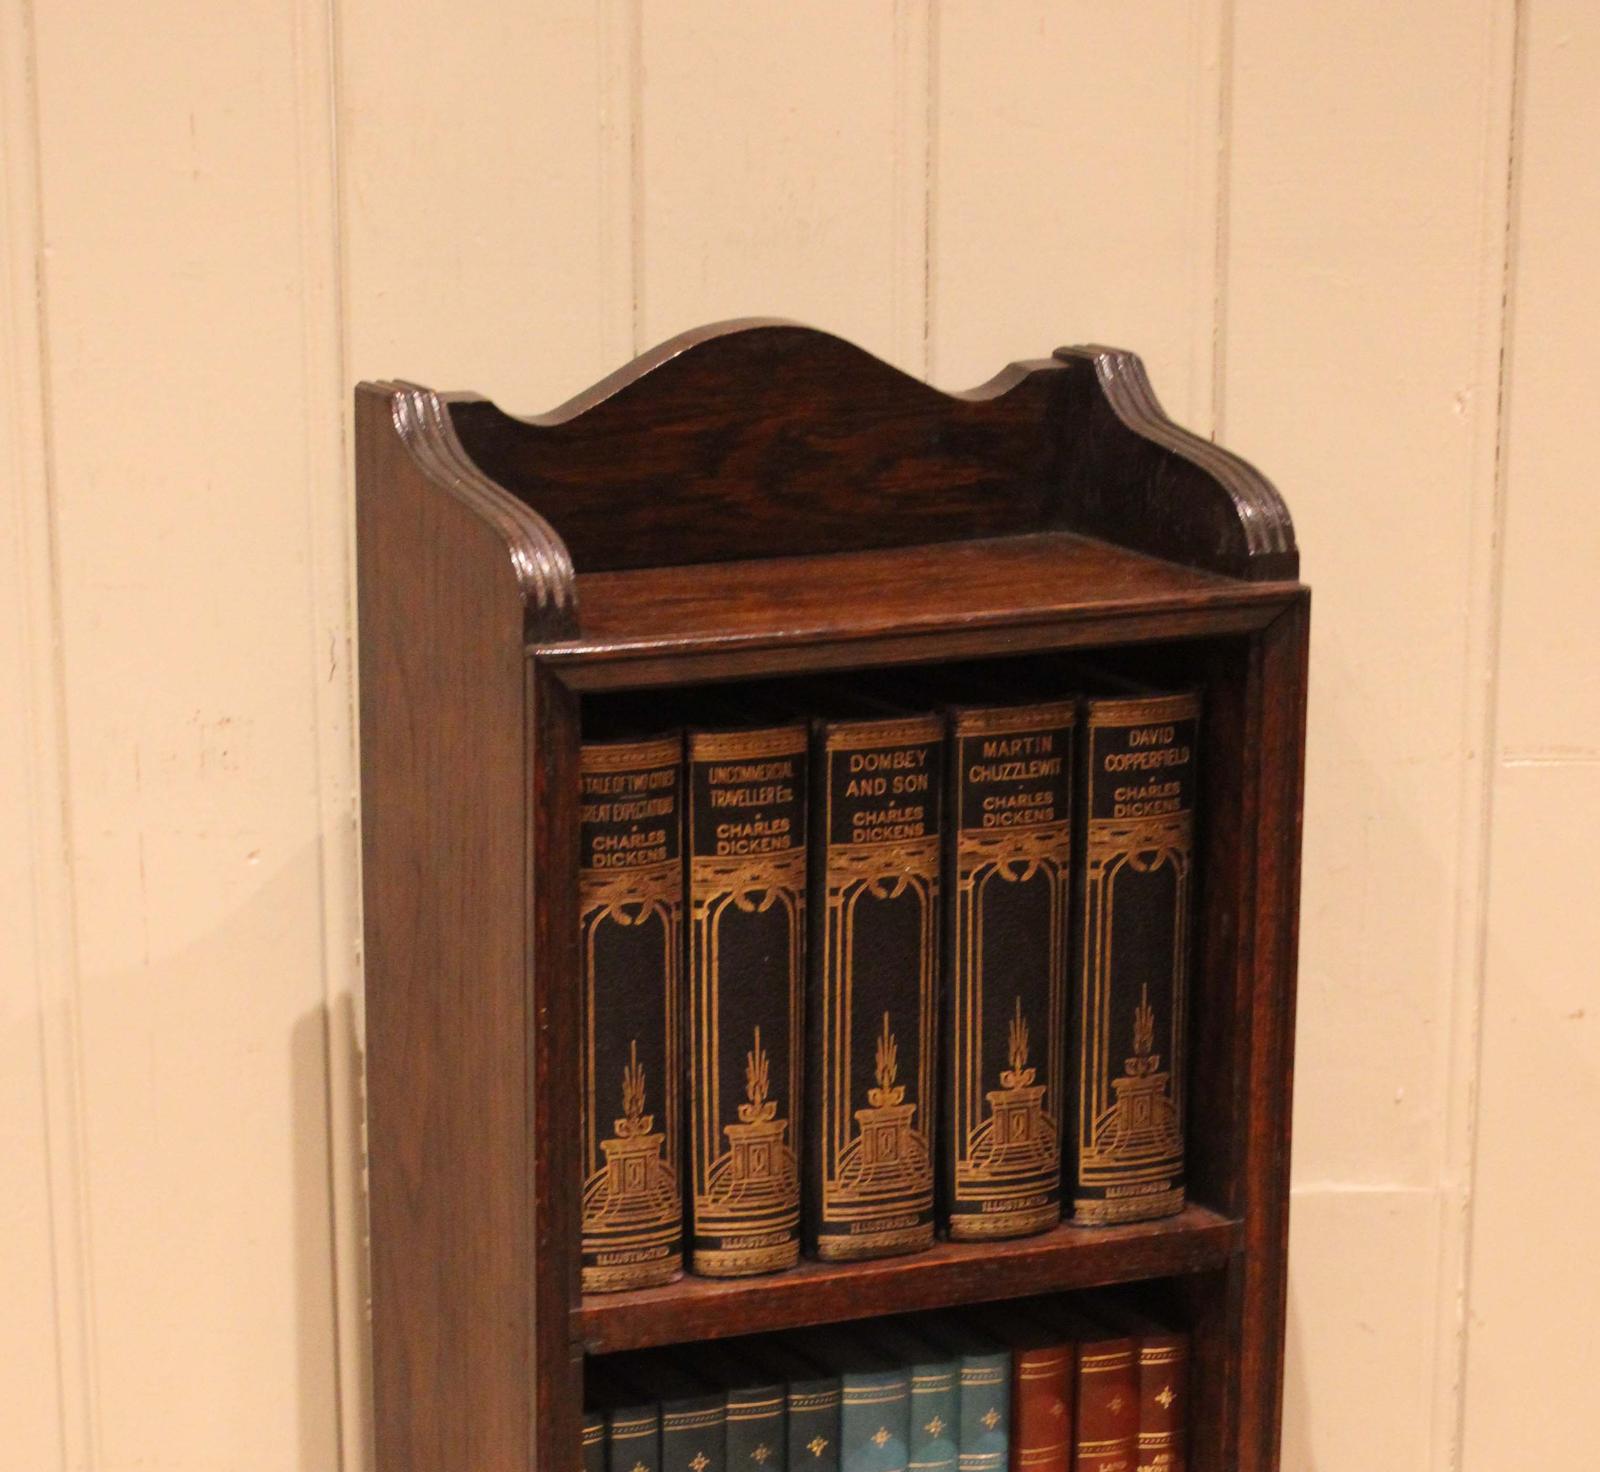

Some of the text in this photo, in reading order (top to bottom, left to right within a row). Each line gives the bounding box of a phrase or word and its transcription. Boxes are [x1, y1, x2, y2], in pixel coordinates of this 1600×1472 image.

[983, 735, 1053, 758] MARTIN
[1129, 727, 1174, 747] DAVID
[850, 749, 928, 772] DOMBEY
[1104, 747, 1190, 772] COPPERFIELD
[709, 762, 793, 784] UNCOMMERCIAL
[969, 758, 1062, 783] CHUZZLEWIT
[845, 774, 929, 797] AND SON
[1114, 782, 1181, 801] CHARLES
[711, 786, 775, 808] TRAVELLER
[983, 792, 1054, 811] CHARLES
[853, 806, 925, 826] CHARLES
[983, 807, 1055, 828] DICKENS
[1114, 798, 1181, 818] DICKENS
[717, 818, 790, 839] CHARLES
[853, 823, 925, 843] DICKENS
[592, 830, 665, 851] CHARLES
[717, 835, 791, 856] DICKENS
[592, 847, 667, 868] DICKENS
